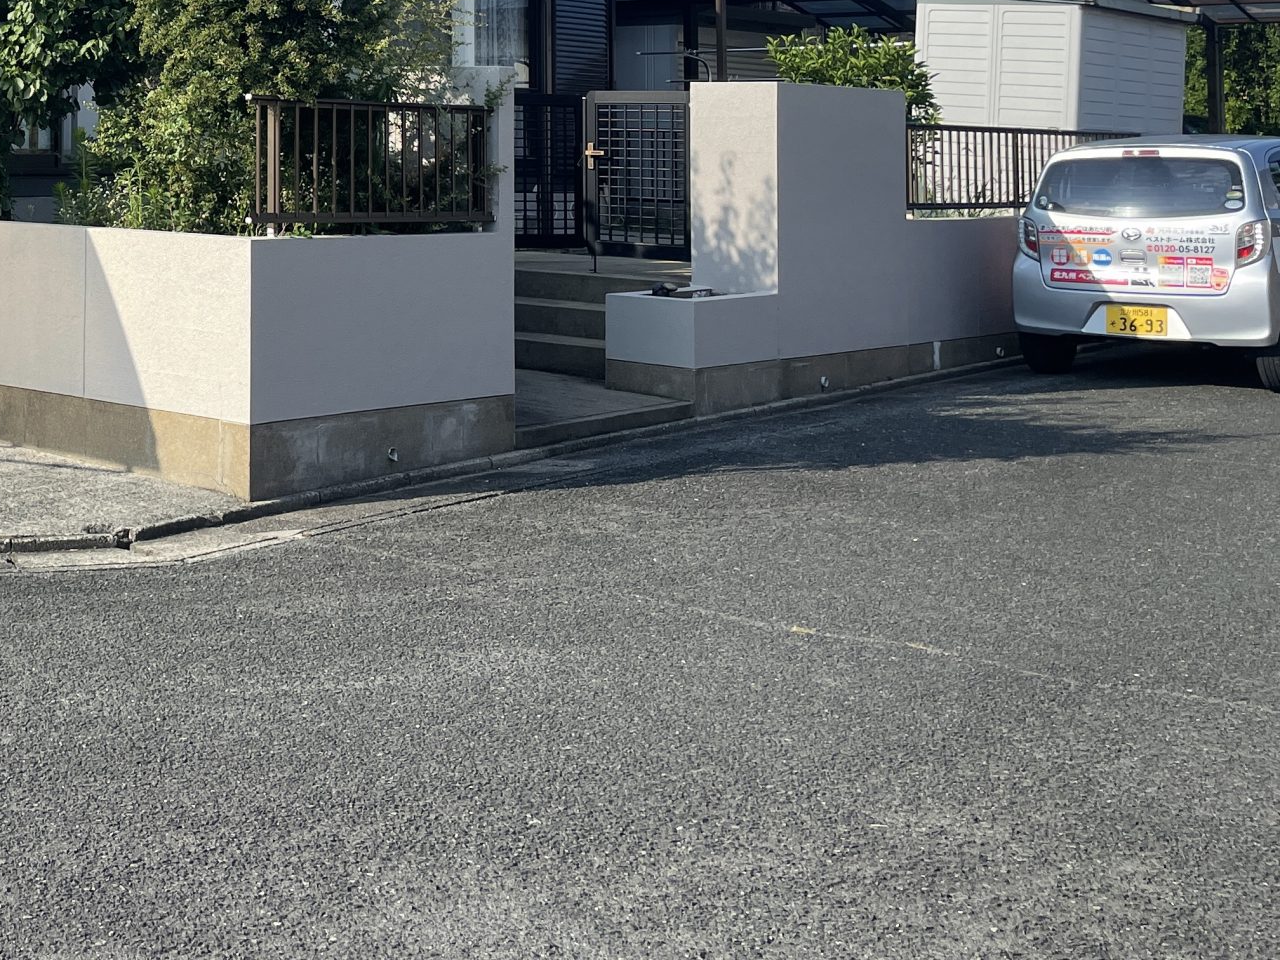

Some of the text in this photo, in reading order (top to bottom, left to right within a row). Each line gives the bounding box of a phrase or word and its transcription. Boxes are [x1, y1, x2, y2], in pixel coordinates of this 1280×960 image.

[1146, 236, 1216, 244] ベストホーム株式会社
[1154, 244, 1216, 253] 0120-05-8127
[1053, 271, 1077, 280] 北九州
[1119, 317, 1164, 333] 36-93
